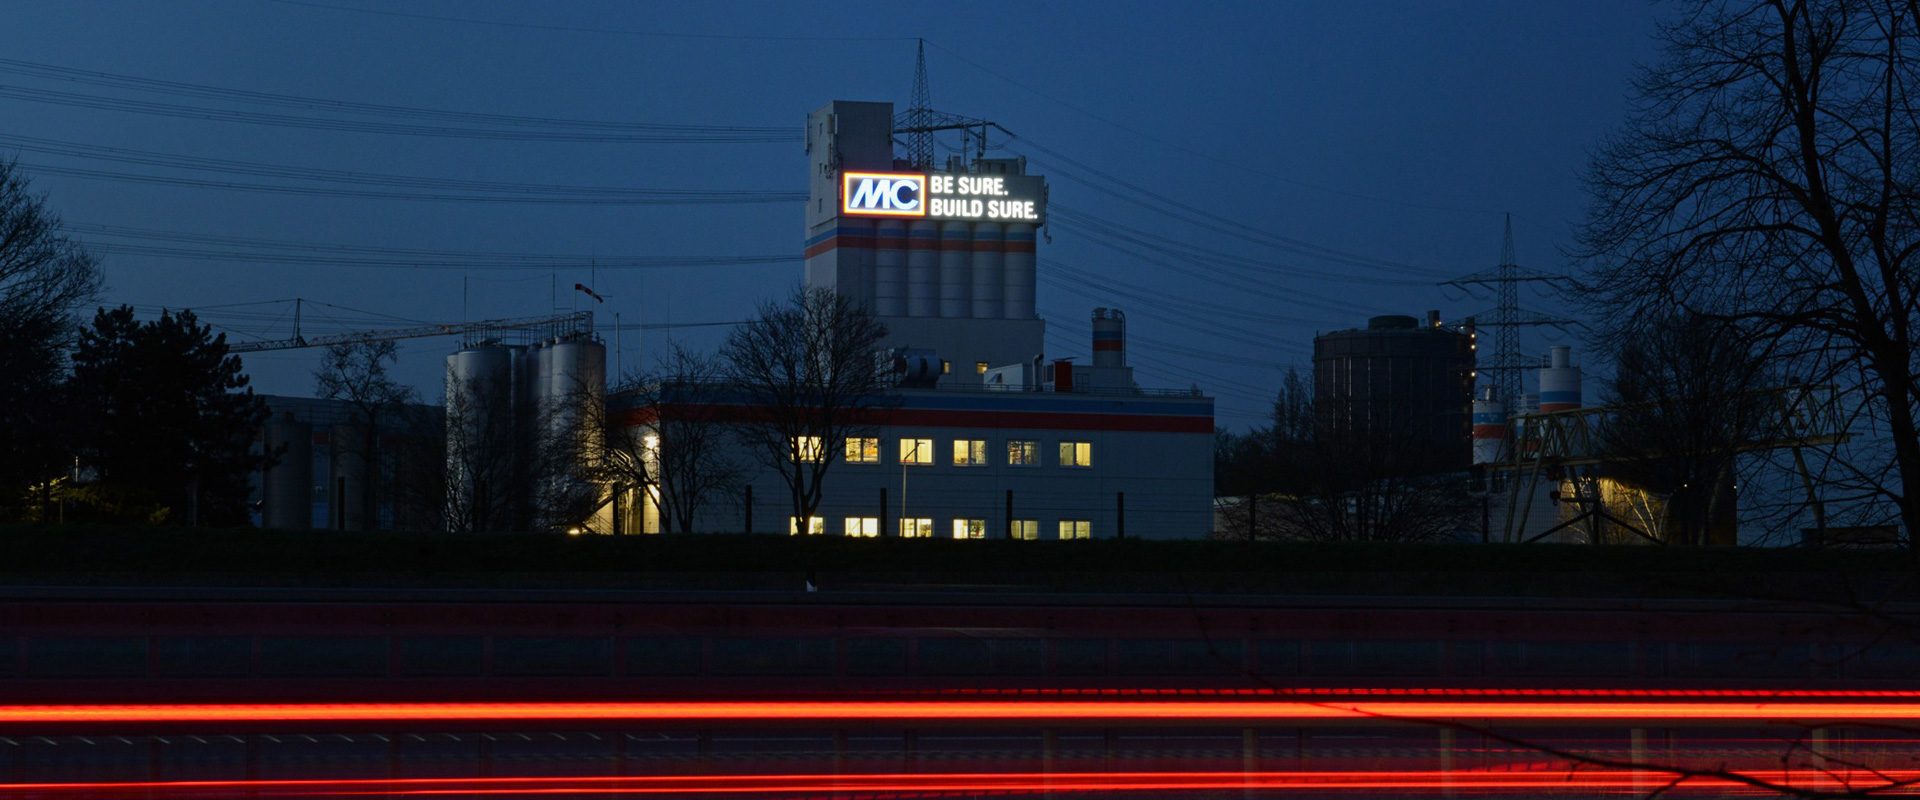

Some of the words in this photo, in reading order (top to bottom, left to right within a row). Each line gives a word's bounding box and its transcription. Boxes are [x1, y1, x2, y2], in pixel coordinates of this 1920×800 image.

[850, 178, 919, 211] MC
[930, 175, 954, 194] BE
[958, 177, 1009, 196] SURE.
[930, 198, 983, 217] BUILD
[987, 200, 1038, 219] SURE.
